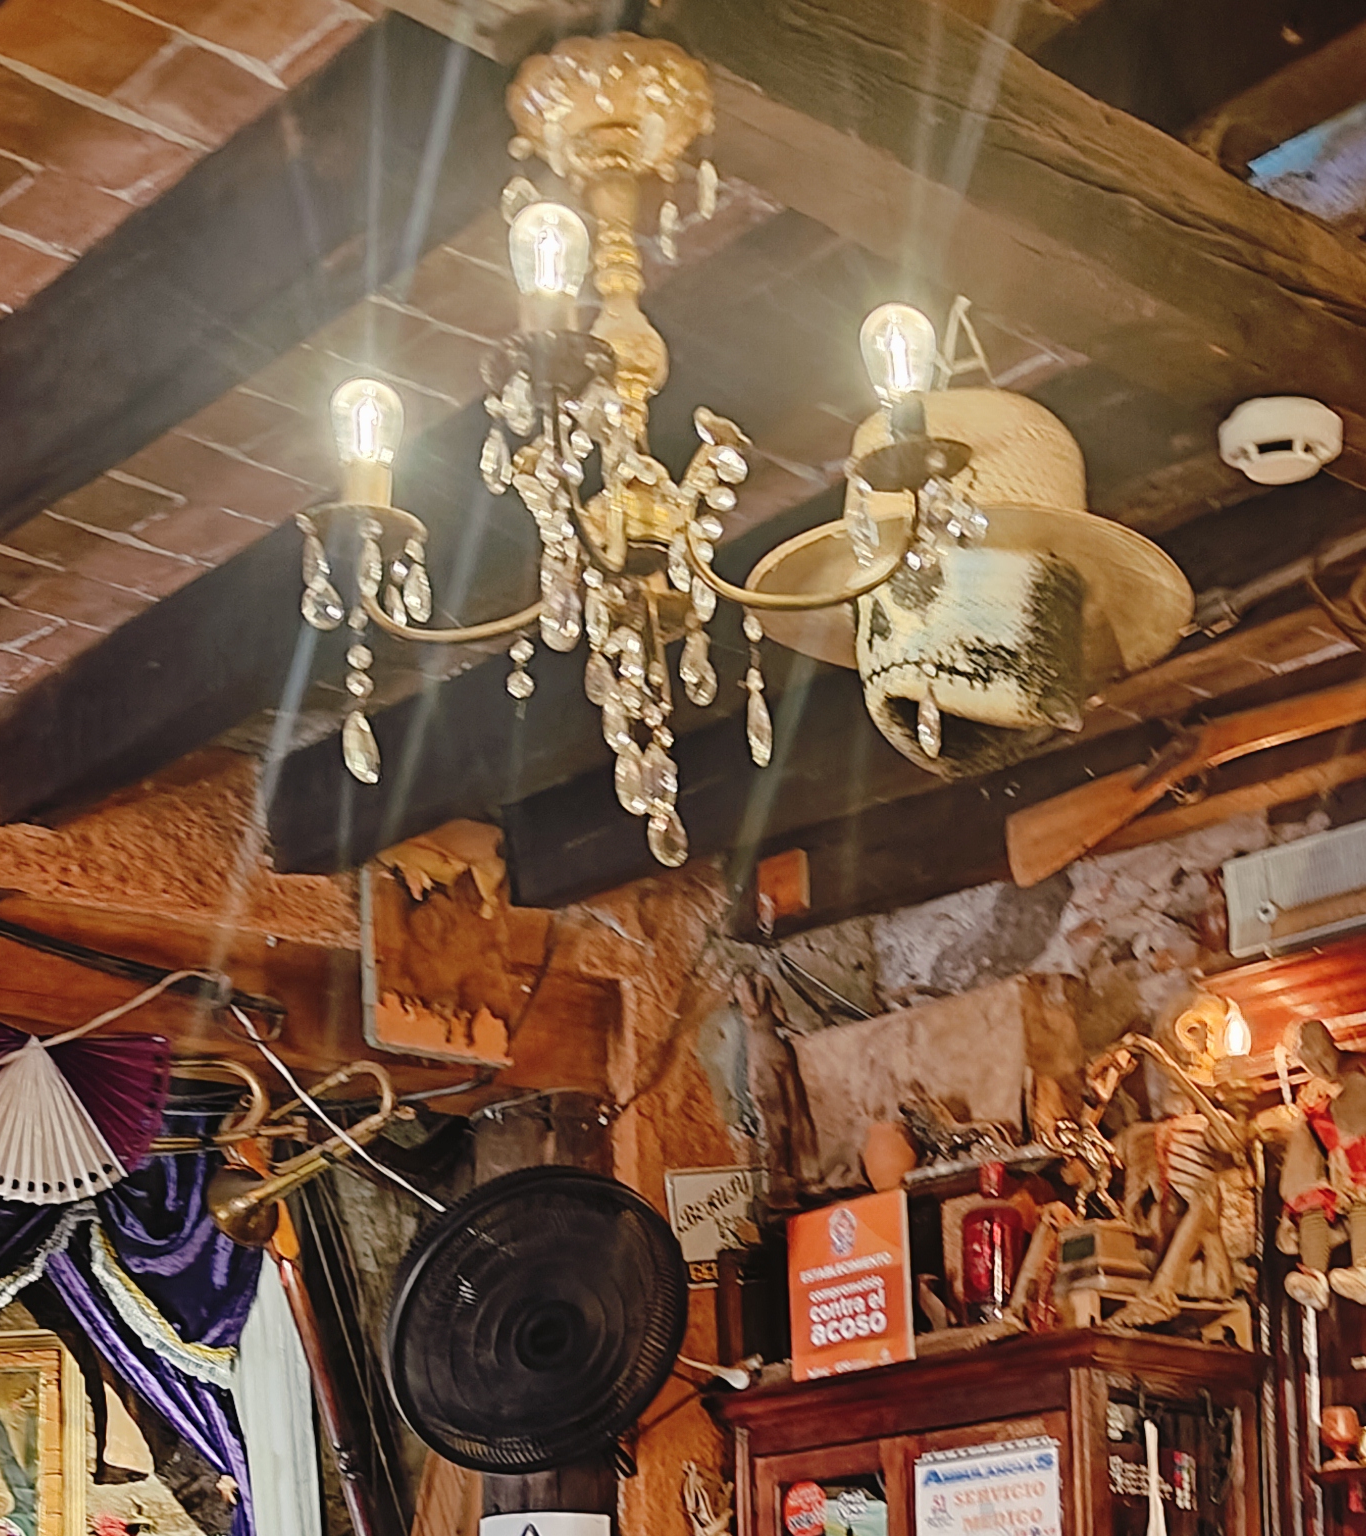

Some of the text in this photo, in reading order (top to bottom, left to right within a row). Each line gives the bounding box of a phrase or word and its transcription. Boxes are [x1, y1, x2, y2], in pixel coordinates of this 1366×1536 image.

[809, 1287, 886, 1323] contra el
[810, 1310, 888, 1347] acoso
[953, 1481, 1046, 1507] SERVICIO
